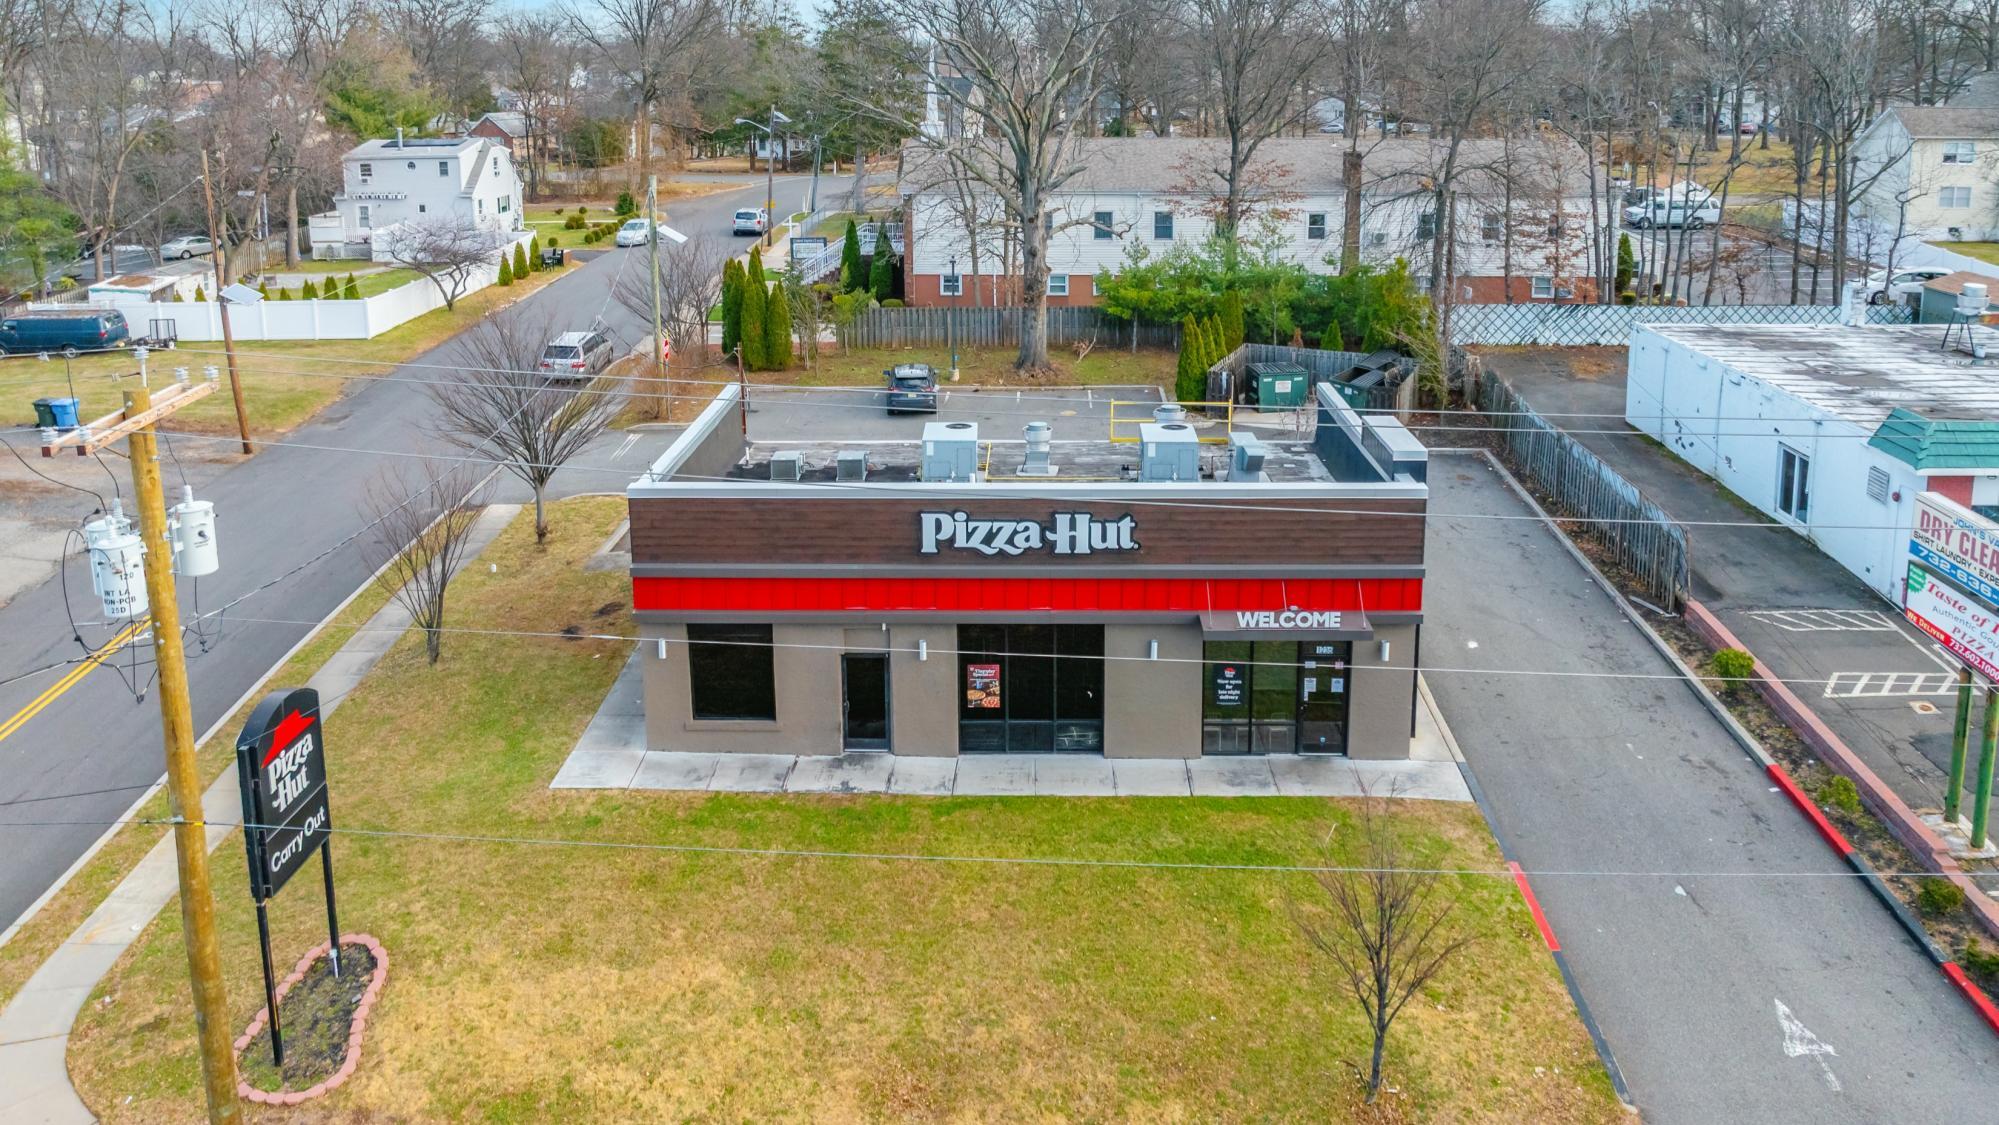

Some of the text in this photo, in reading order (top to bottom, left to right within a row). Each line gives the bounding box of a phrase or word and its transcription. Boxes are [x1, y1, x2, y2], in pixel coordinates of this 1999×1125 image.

[920, 511, 1138, 556] Pizza Hut
[1920, 509, 1954, 546] DRY
[1953, 516, 1986, 541] JOHN'S
[1913, 530, 1935, 548] SHIRT
[1936, 543, 1973, 570] LAUNDRY
[1237, 611, 1341, 628] WELCOME
[1928, 580, 1991, 628] Taste of
[1932, 605, 1977, 632] Authentic
[1952, 626, 1995, 661] PIZZA
[267, 732, 315, 795] Pizza
[272, 765, 310, 813] Hut
[271, 805, 326, 873] Carry Out
